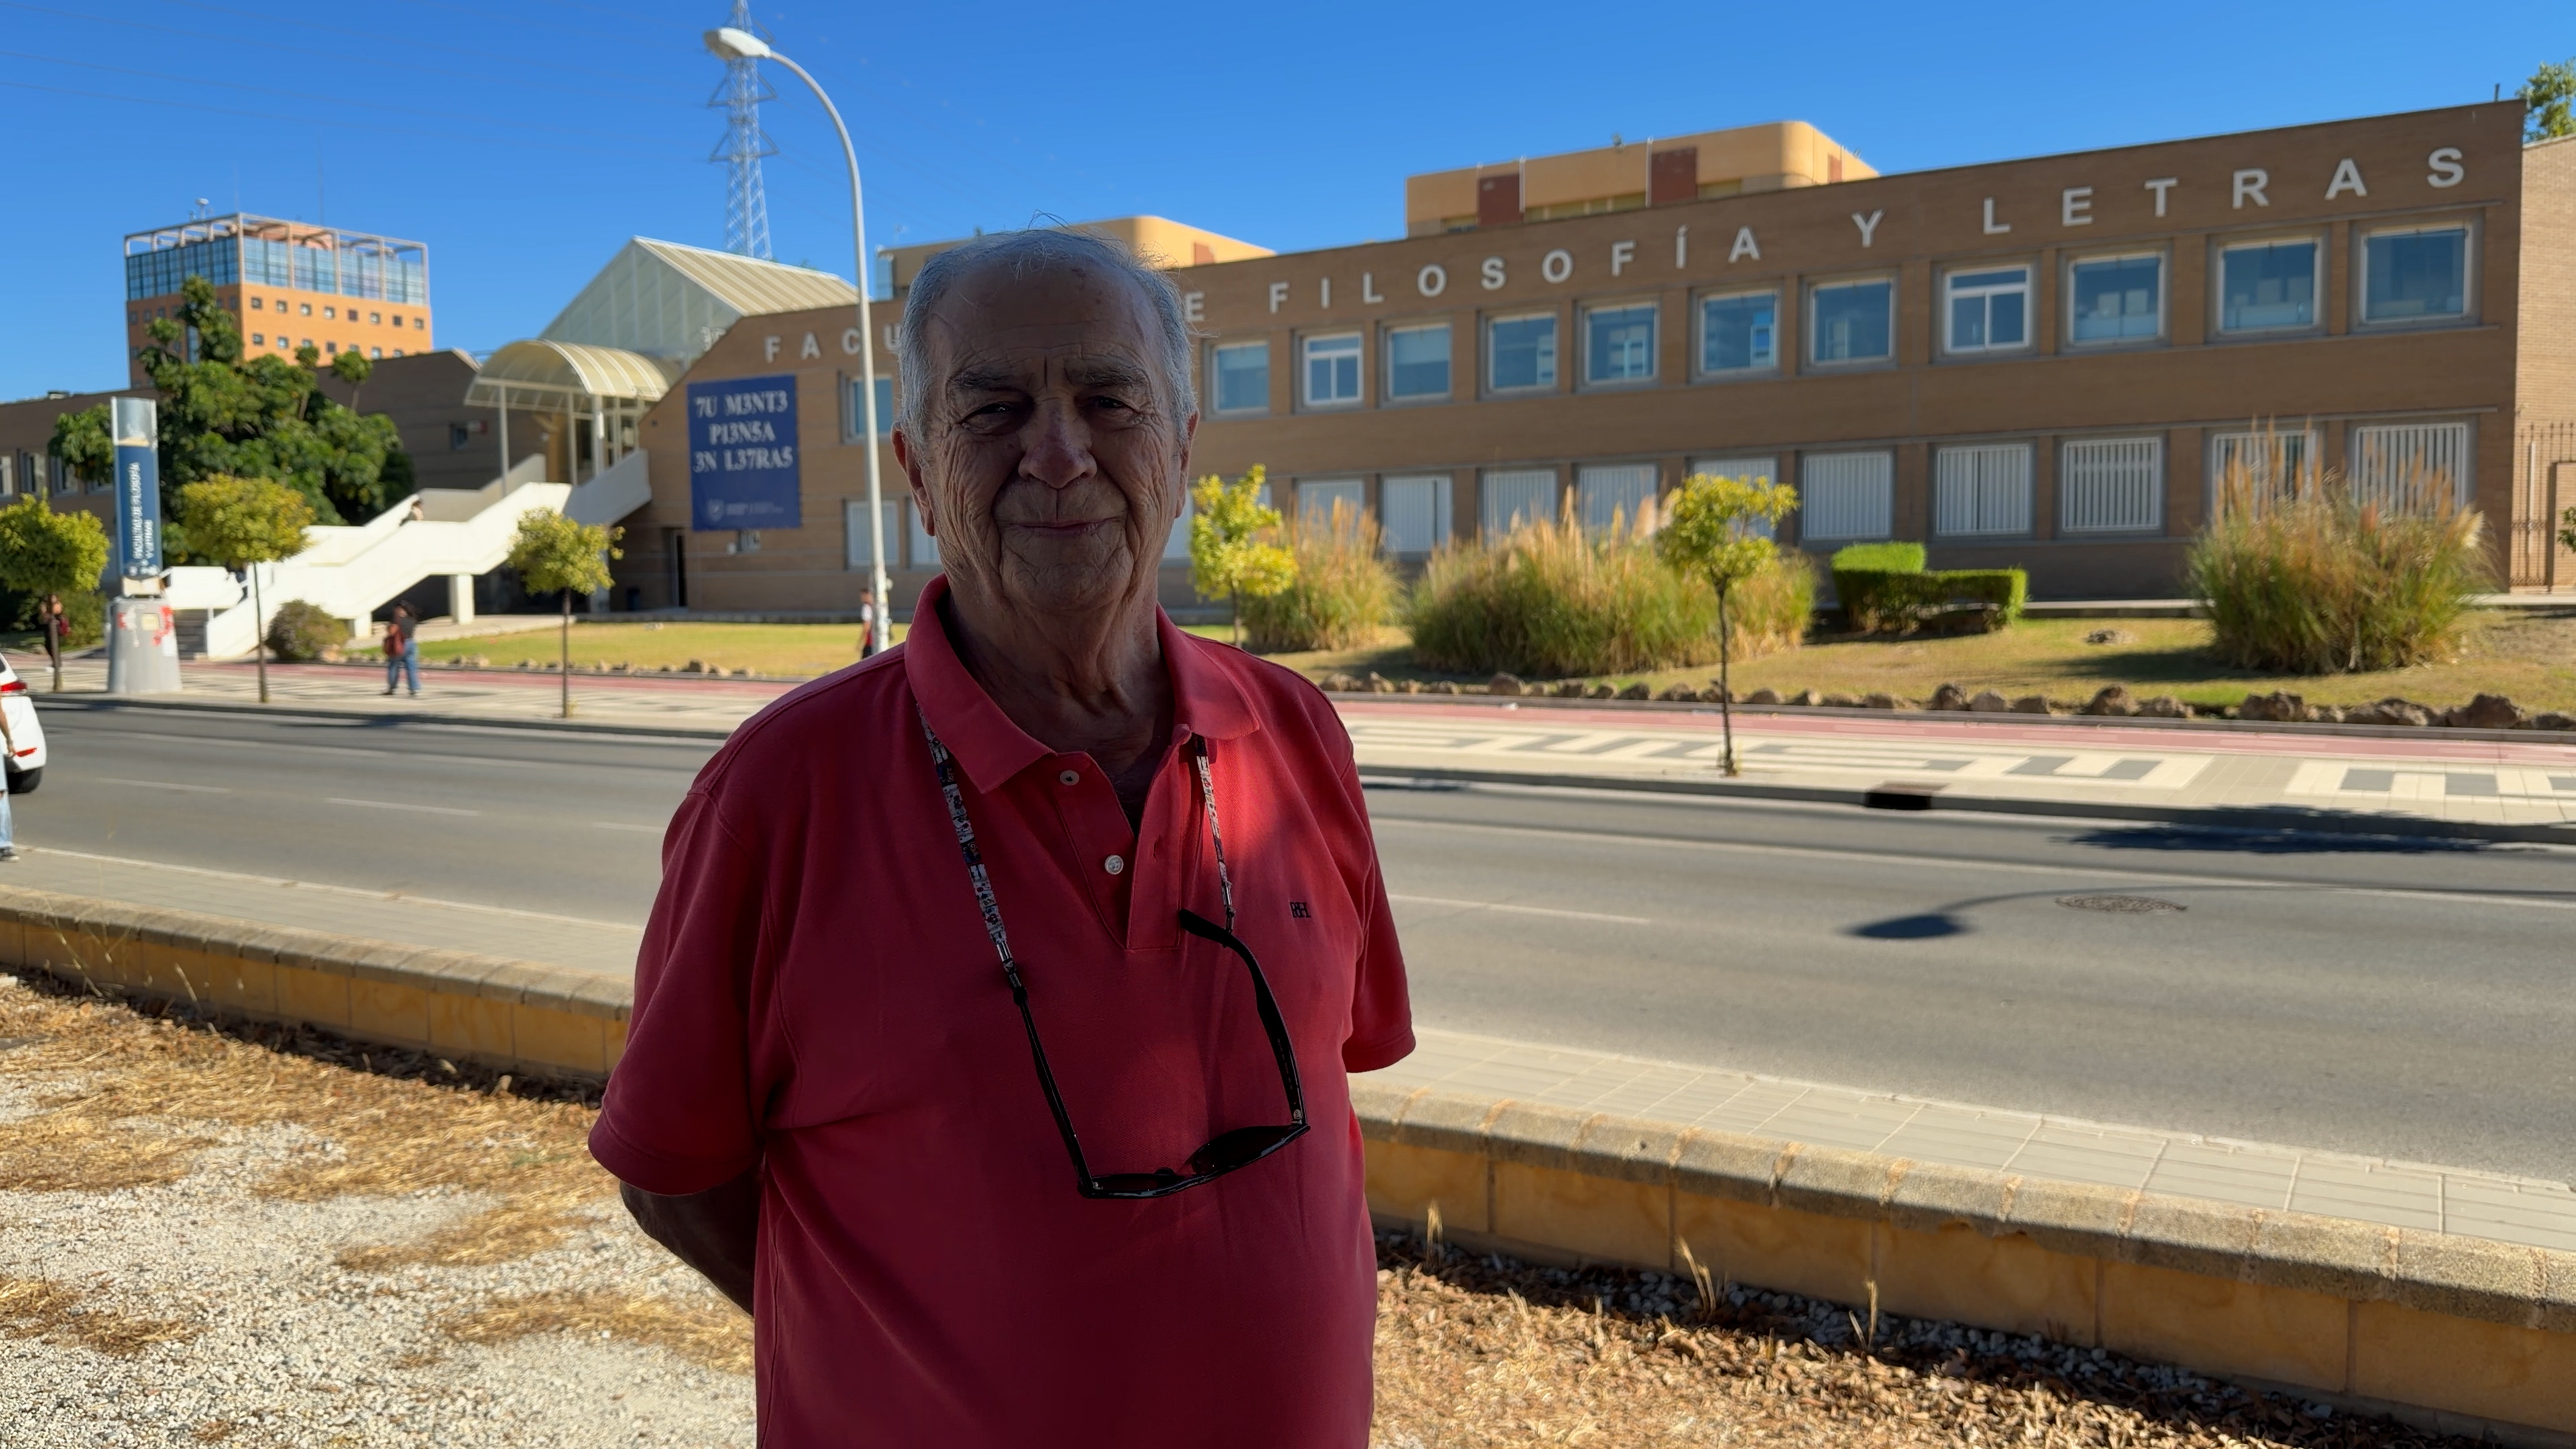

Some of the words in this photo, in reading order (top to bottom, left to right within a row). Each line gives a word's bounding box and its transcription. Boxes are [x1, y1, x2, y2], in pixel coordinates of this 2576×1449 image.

[765, 323, 901, 363] FACU
[1185, 291, 1205, 323] E
[1269, 224, 1762, 314] FILOSOFÍA
[1851, 209, 1884, 248] Y
[1983, 147, 2465, 235] LETRAS
